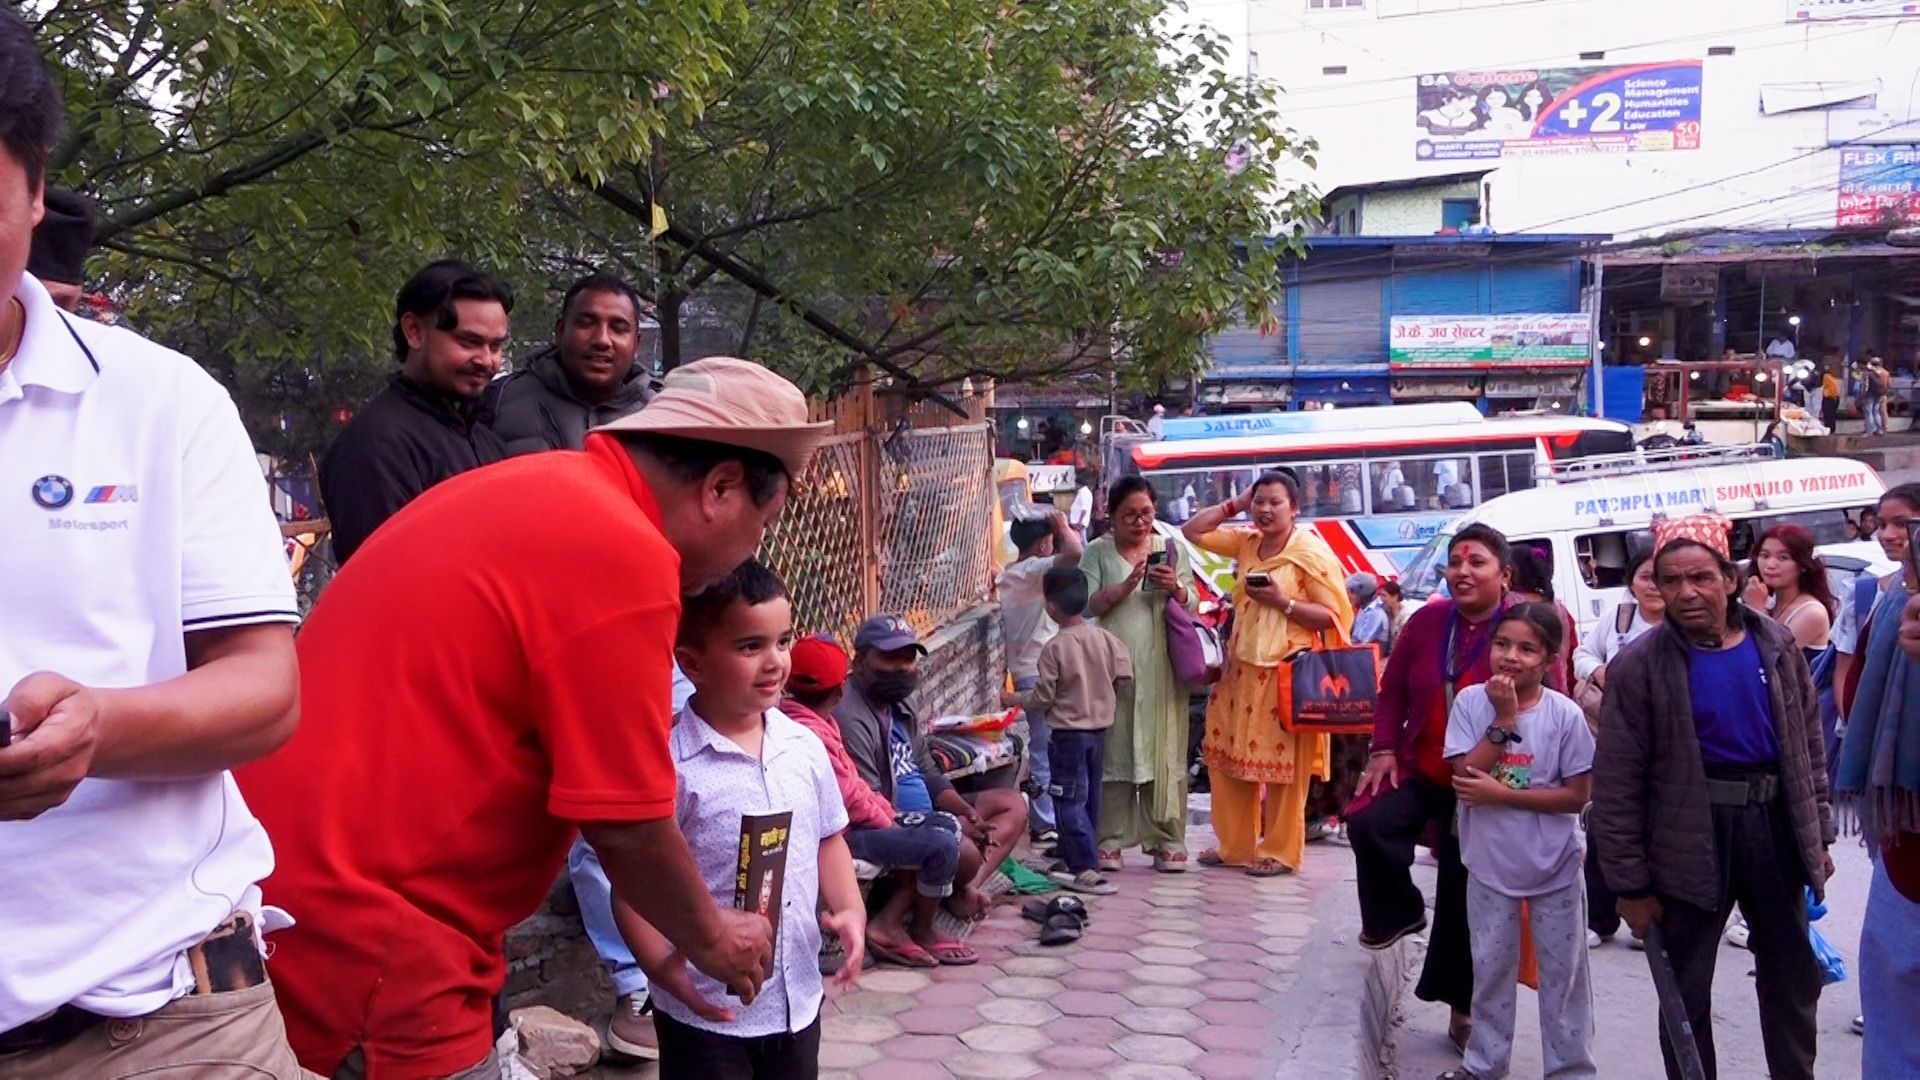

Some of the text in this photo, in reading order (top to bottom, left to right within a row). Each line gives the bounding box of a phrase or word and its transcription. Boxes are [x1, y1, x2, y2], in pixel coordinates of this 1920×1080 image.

[1623, 79, 1668, 88] Science
[1624, 86, 1700, 98] Management
[1624, 97, 1690, 109] Humanities
[1559, 92, 1621, 133] +2
[1623, 109, 1681, 120] Education
[1623, 121, 1647, 130] Law
[1844, 151, 1887, 166] FLEX
[1799, 472, 1866, 492] YATAYAT
[49, 518, 129, 531] Motorsport
